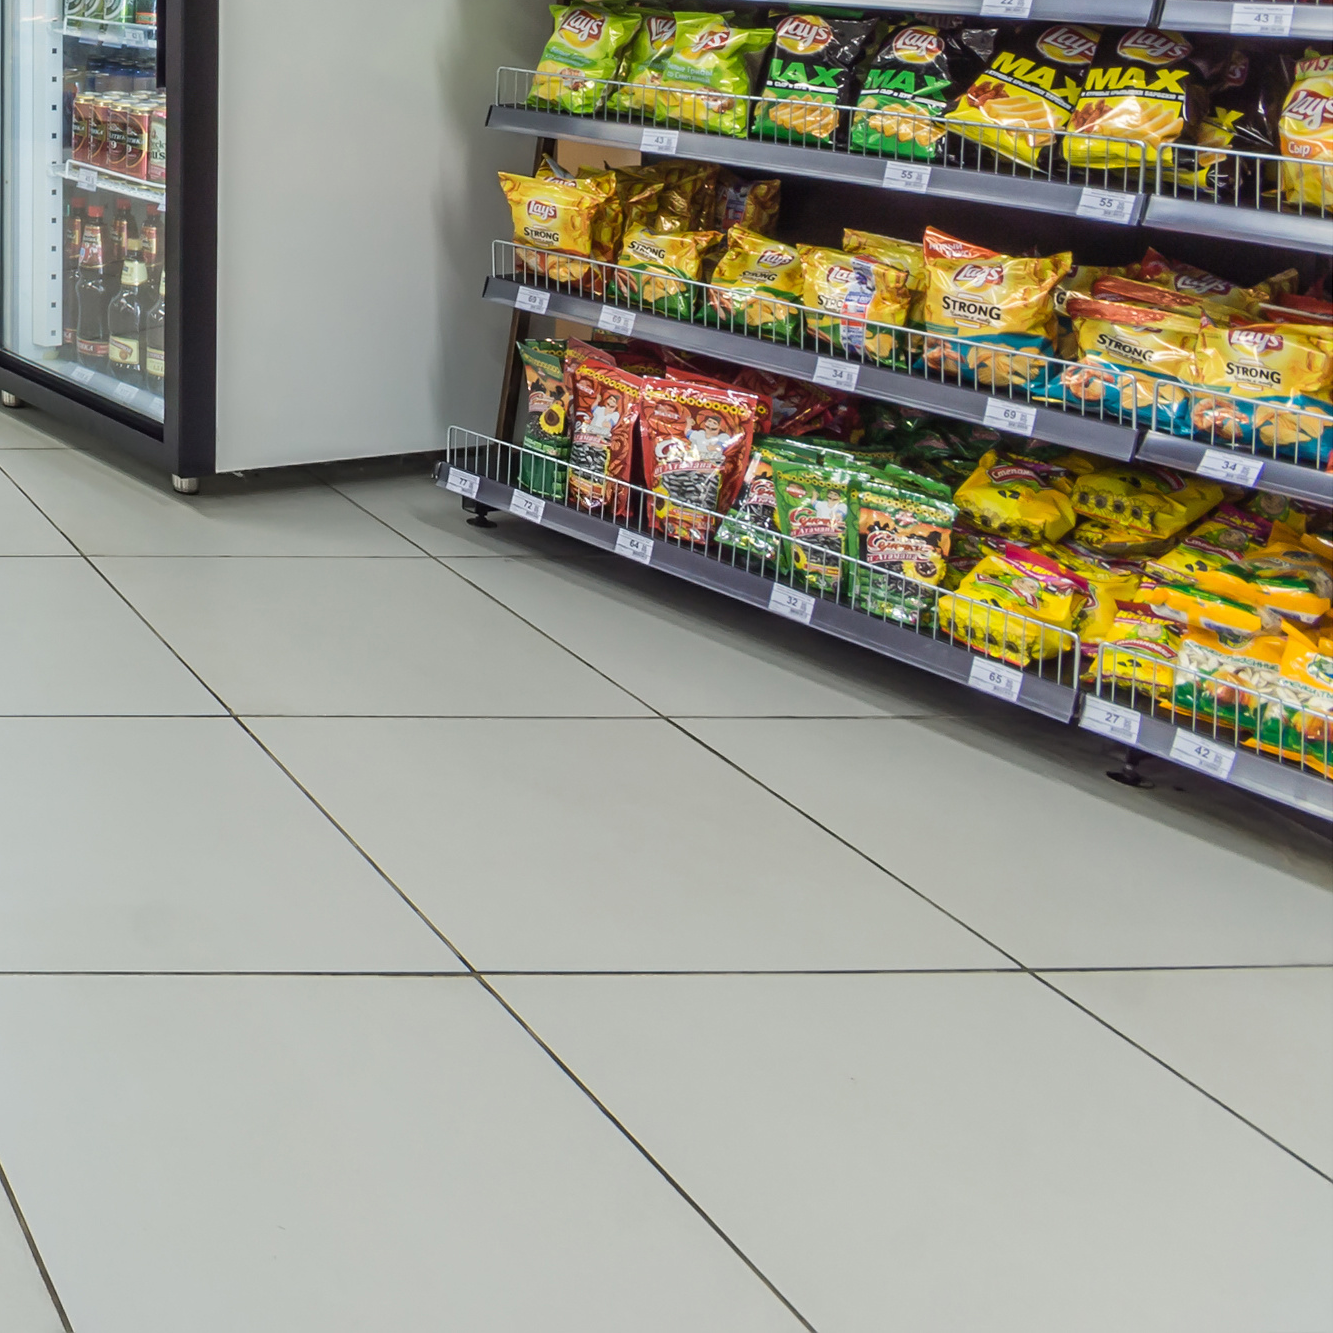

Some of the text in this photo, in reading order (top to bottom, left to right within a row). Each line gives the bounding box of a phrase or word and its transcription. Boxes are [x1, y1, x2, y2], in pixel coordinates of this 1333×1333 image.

[562, 10, 602, 42] Lay's
[1254, 12, 1270, 24] 43
[779, 18, 829, 48] Lay's
[895, 28, 938, 52] Lay's
[1125, 29, 1189, 58] Lay's
[992, 51, 1084, 106] MAX
[1084, 68, 1190, 94] MAX
[653, 136, 665, 145] 43
[1288, 142, 1312, 158] Сыр
[900, 170, 914, 180] 55
[527, 199, 557, 221] Lay's
[1098, 197, 1114, 208] 55
[523, 226, 560, 243] STRONG
[629, 240, 666, 260] STRONG
[760, 250, 794, 266] Lay's
[957, 264, 1003, 285] Lay's
[527, 295, 537, 303] 69
[942, 295, 1001, 321] STRONG
[612, 315, 622, 324] 69
[1097, 333, 1155, 363] STRONG
[832, 369, 844, 379] 34
[1226, 361, 1282, 385] STRONG
[1002, 408, 1018, 420] 69
[1220, 460, 1238, 472] 34
[459, 477, 468, 486] 77
[522, 499, 533, 509] 72
[629, 539, 640, 550] 64
[786, 596, 799, 607] 32
[988, 672, 1003, 685] 65
[1105, 711, 1121, 724] 27
[1194, 743, 1211, 760] 42
